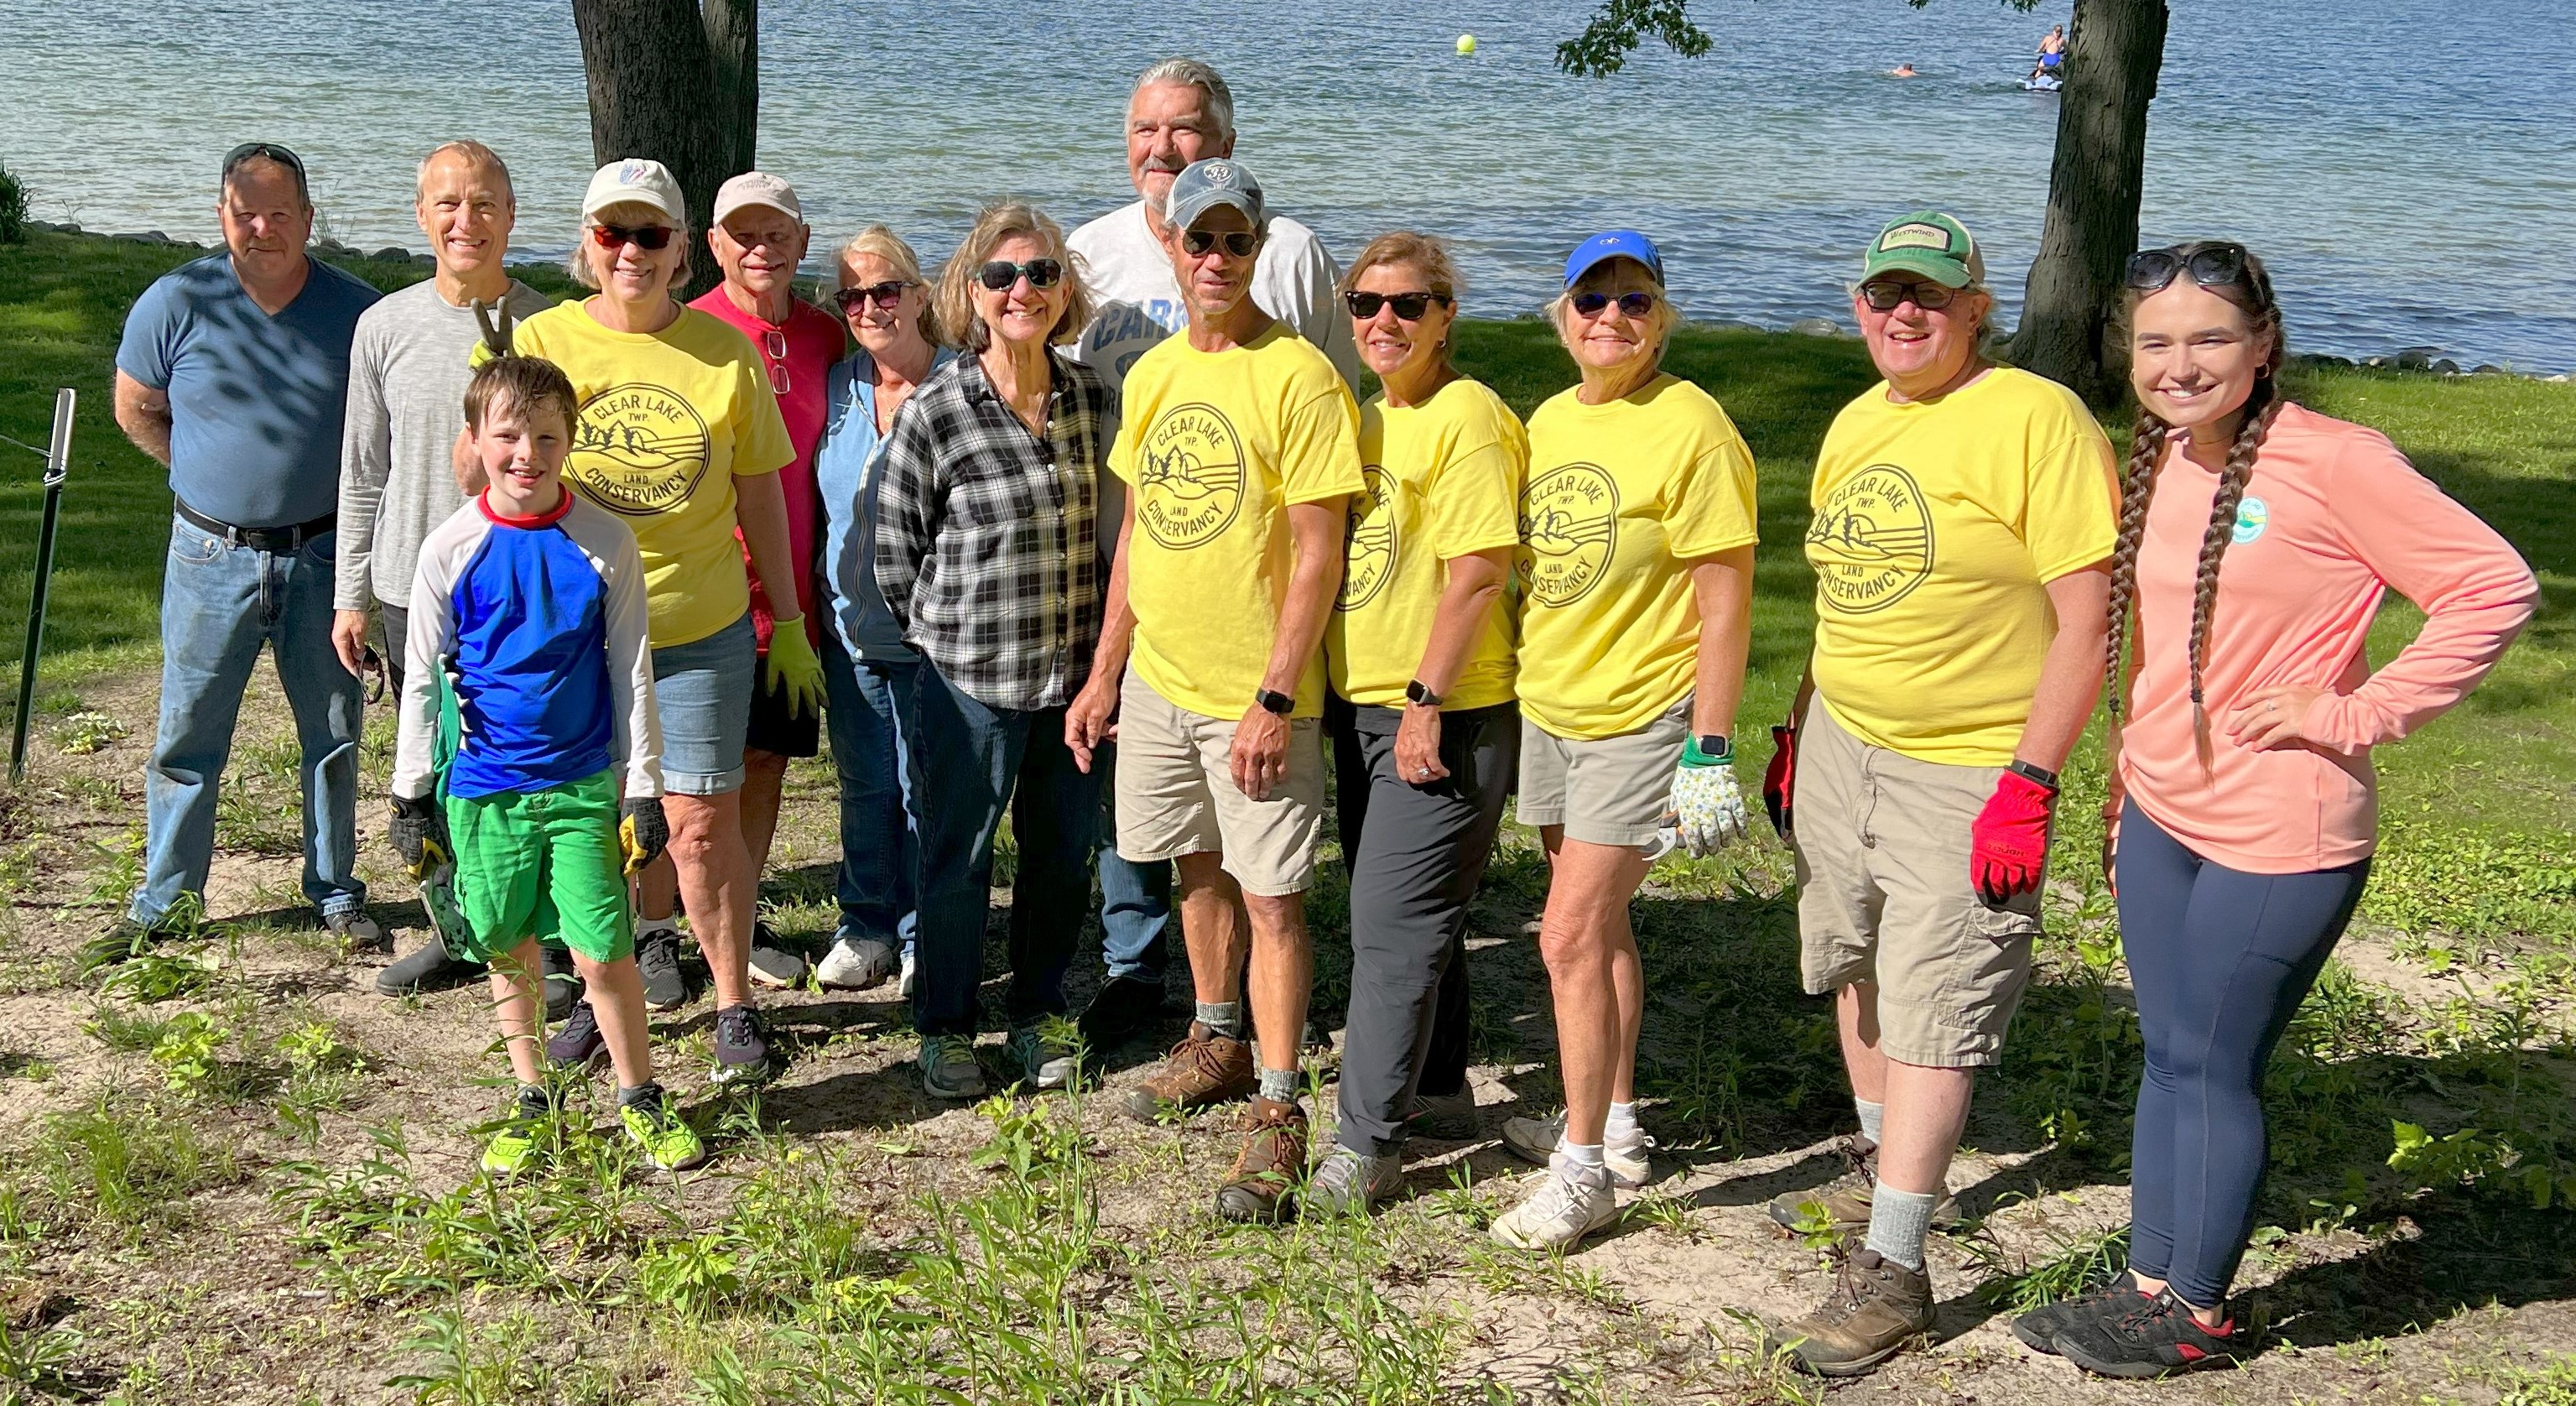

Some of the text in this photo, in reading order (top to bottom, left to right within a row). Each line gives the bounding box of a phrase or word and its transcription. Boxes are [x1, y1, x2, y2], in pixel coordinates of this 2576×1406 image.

[1890, 229, 1935, 239] WESTWIND
[593, 394, 684, 424] CLEAR LAKE
[1158, 416, 1225, 450] CLEAR LAKE
[585, 466, 688, 504] CONSERVANCY
[623, 474, 648, 485] LAND
[1366, 479, 1391, 511] LAKE
[1530, 475, 1605, 506] CLEAR LAKE
[1834, 476, 1909, 513] CLEAR LAKE
[1147, 499, 1224, 538] CONSERVANCY
[1170, 506, 1188, 516] LAND
[1544, 563, 1564, 574] LAND
[1820, 563, 1907, 600] ONSERVANCY
[1841, 565, 1864, 578] LAND
